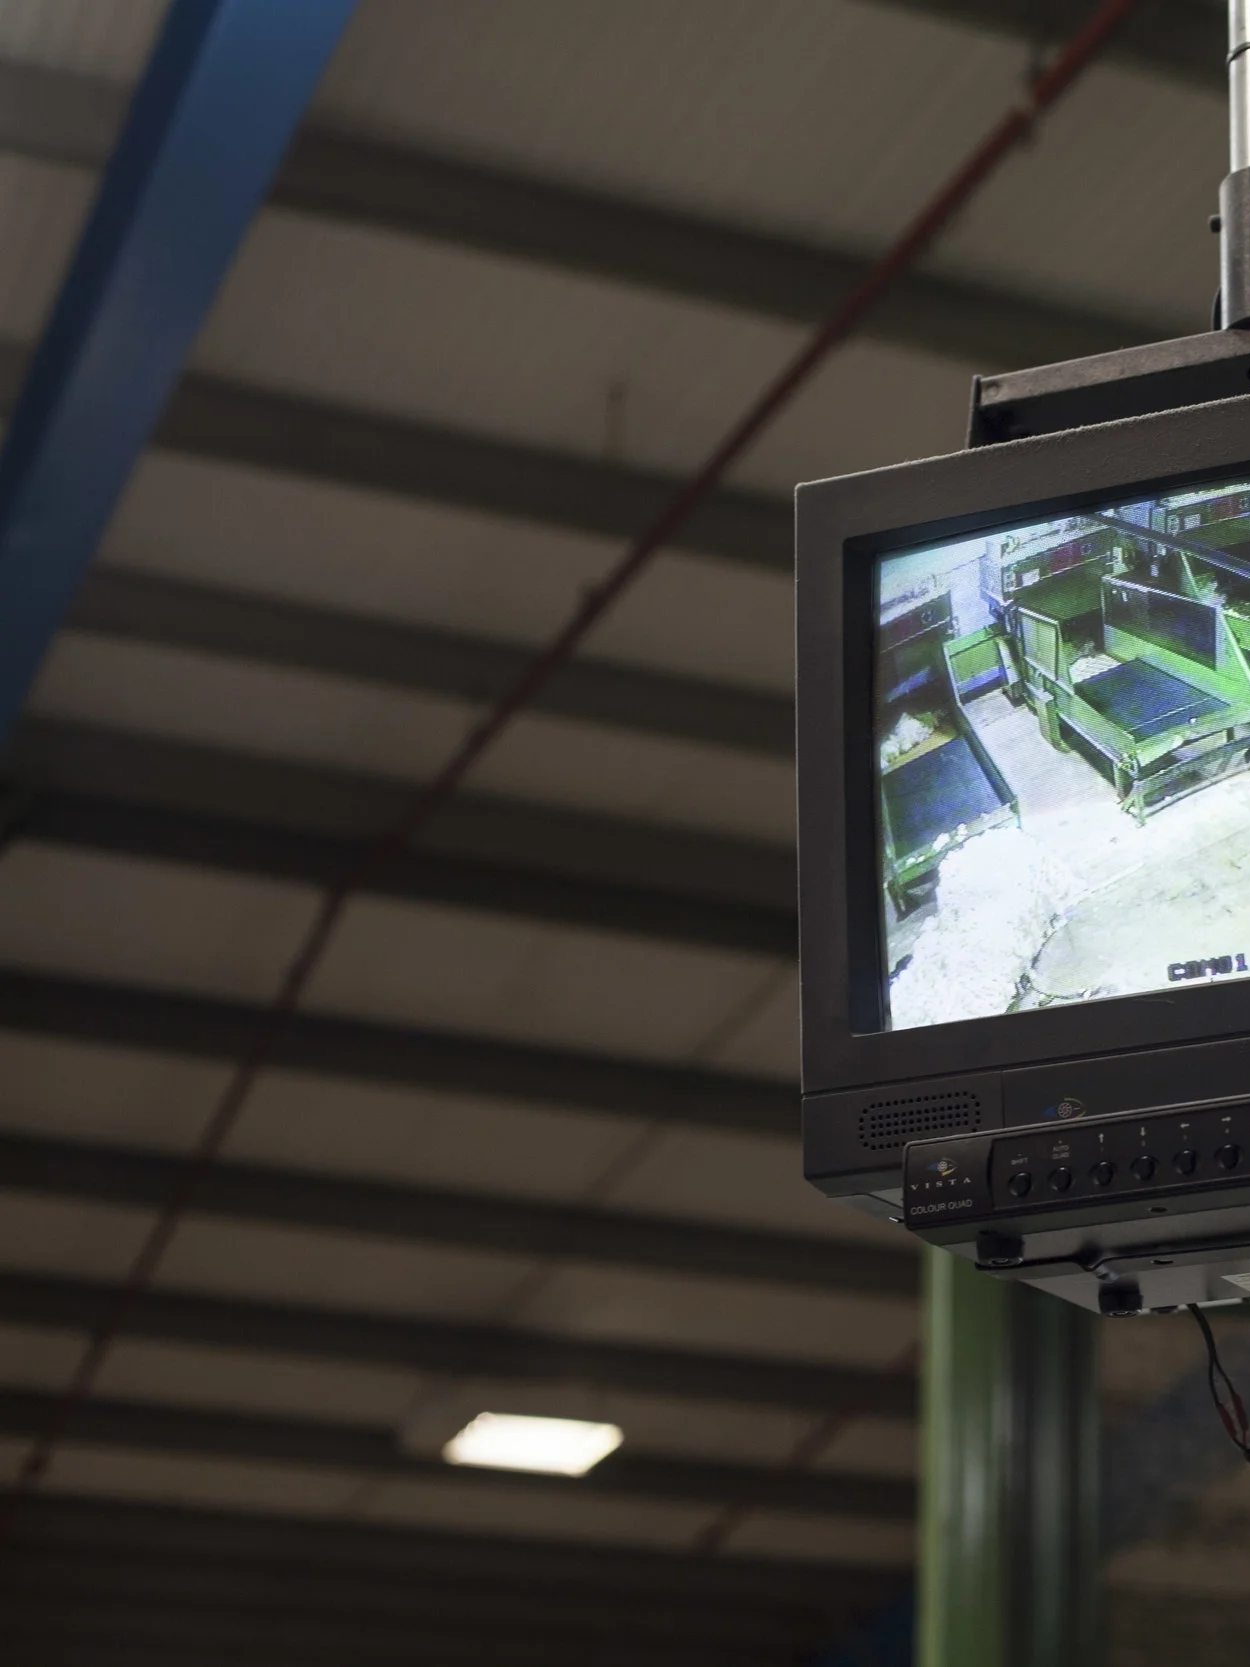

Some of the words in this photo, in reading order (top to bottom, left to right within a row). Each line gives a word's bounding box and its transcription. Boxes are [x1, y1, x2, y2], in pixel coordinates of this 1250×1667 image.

[910, 1177, 972, 1190] VISTA
[910, 1203, 946, 1215] COLOUR
[947, 1199, 973, 1210] QUAD
